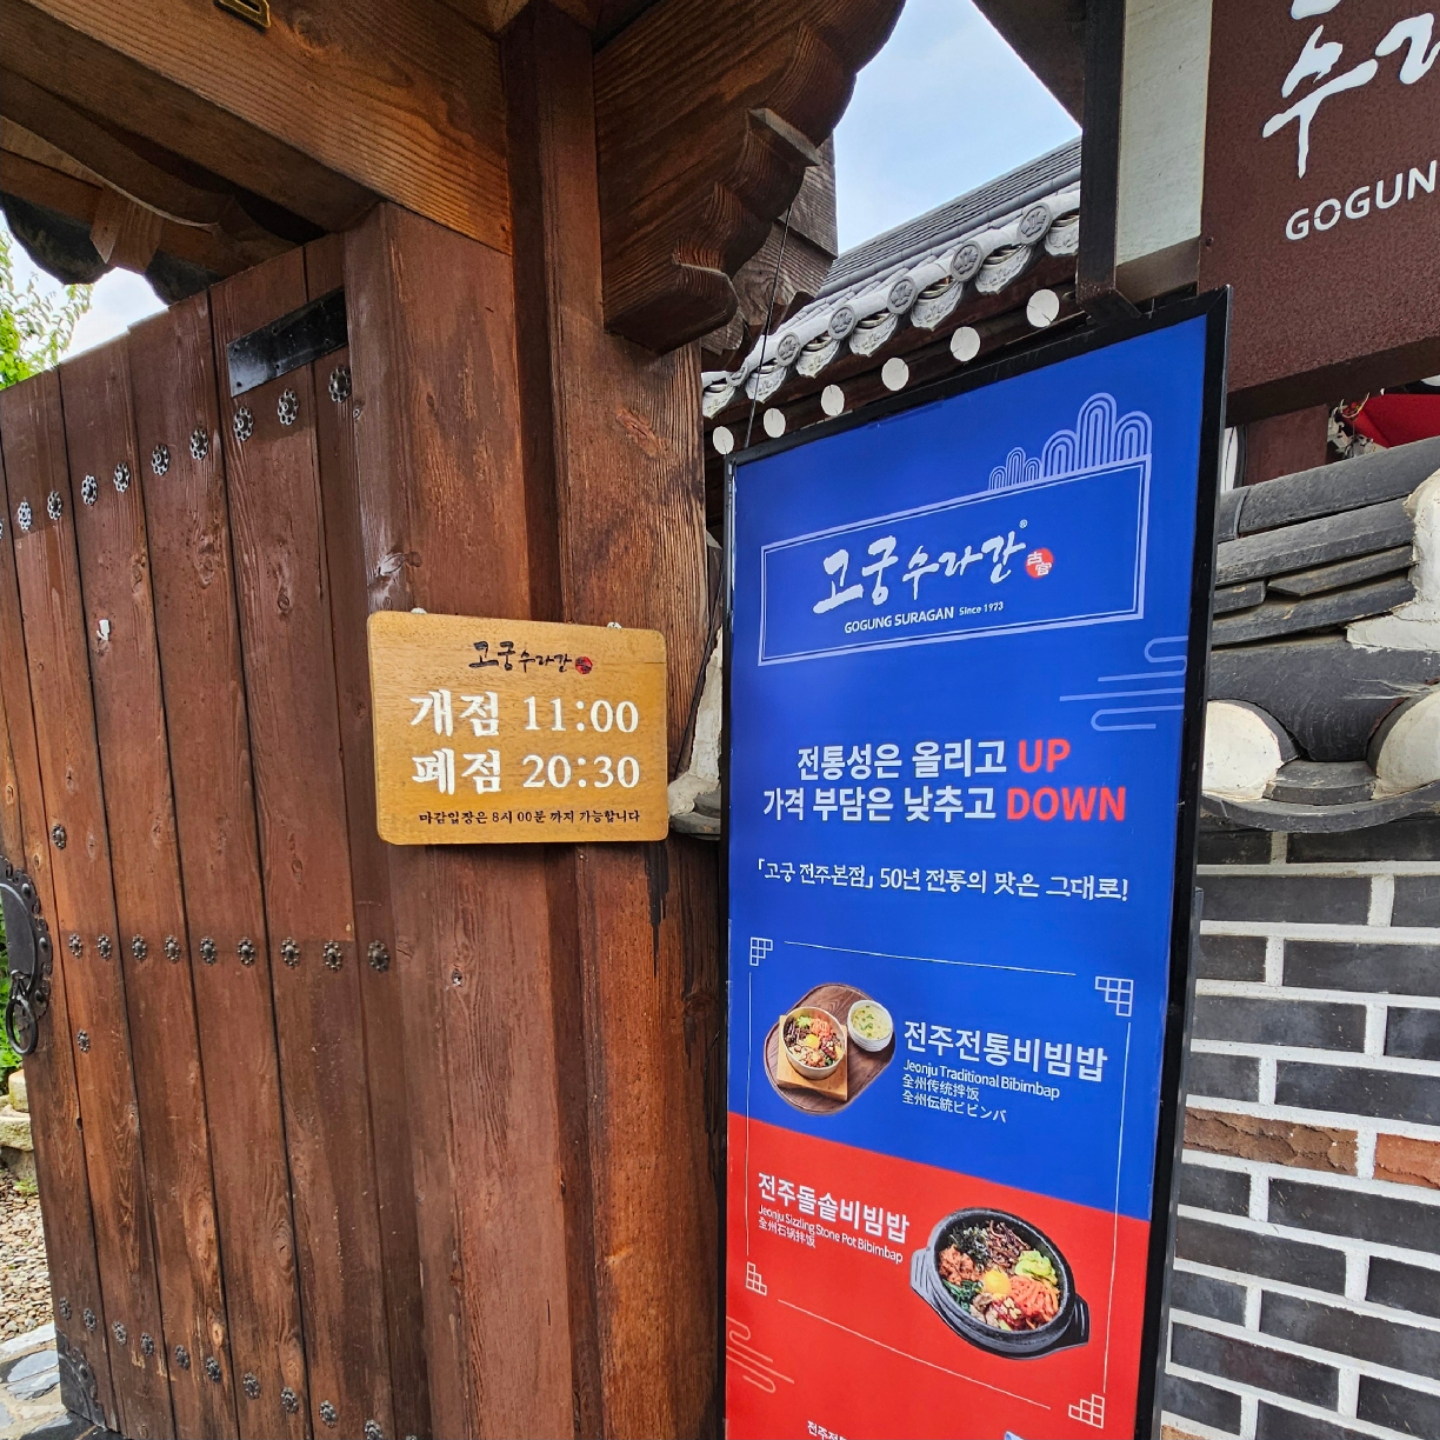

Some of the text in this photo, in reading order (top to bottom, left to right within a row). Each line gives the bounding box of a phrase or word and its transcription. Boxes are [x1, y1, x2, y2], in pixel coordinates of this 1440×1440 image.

[1285, 160, 1437, 240] GOGUN
[844, 601, 1003, 633] GOGUNG SURAGAN Since 1973
[410, 689, 639, 737] 개점 11:00
[412, 747, 640, 795] 폐점 20:30
[798, 739, 1071, 780] 전통성은 올리고 UP
[419, 810, 487, 824] 마감입장은
[492, 810, 512, 824] 8시
[550, 810, 574, 823] 까지
[580, 810, 639, 823] 가능합니다
[763, 786, 1126, 822] 가격 부담은 낮추고 DOWN
[758, 859, 1128, 902] 「고궁 전주본점」 50년 전통의 맛은 그대로!
[904, 1021, 1107, 1082] 전주전통비빔밥
[903, 1059, 1060, 1100] Jeonju Traditional Bibimbap
[759, 1173, 909, 1244] 전주돌솥비빔밥
[759, 1205, 903, 1264] Jeonju Sizzling Stone Pot Bibimbap
